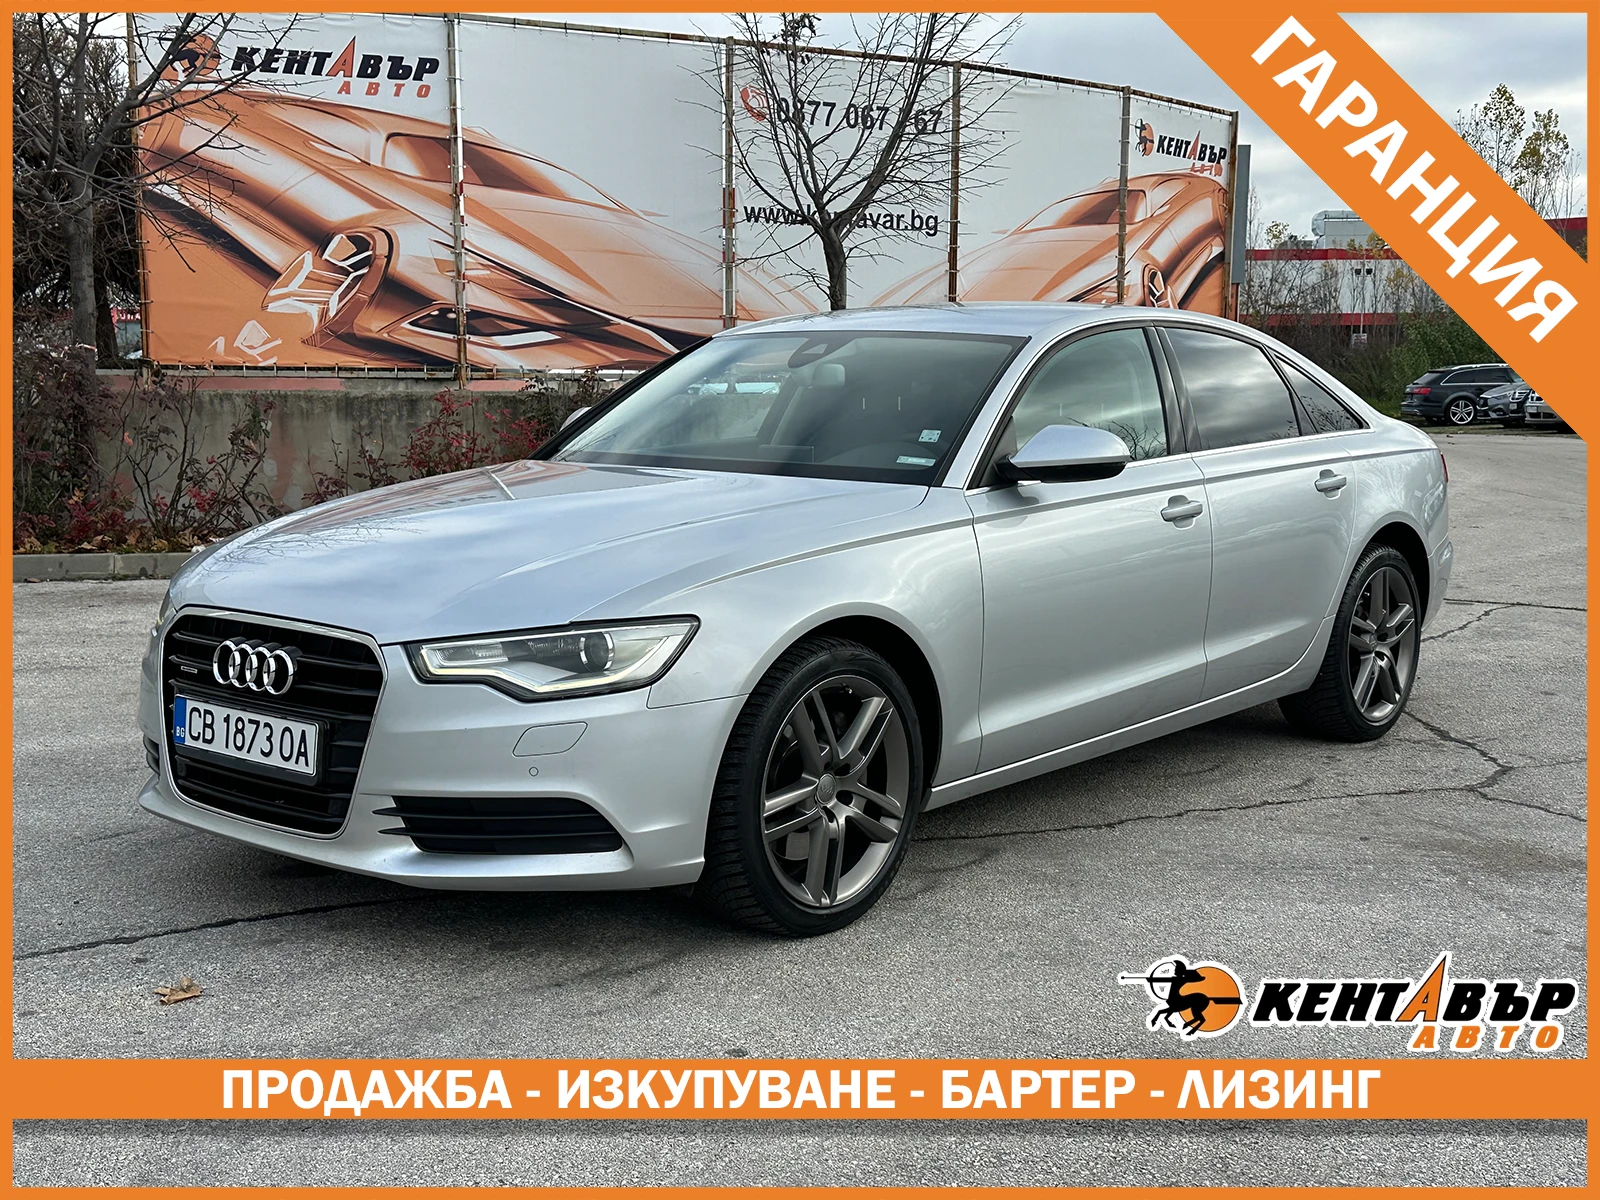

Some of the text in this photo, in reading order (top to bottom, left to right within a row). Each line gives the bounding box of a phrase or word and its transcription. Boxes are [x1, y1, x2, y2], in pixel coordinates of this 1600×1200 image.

[231, 35, 440, 81] КЕНТАВЪР
[337, 80, 431, 98] АВТО
[776, 97, 943, 133] 0877 067 67
[1156, 130, 1227, 164] КЕНТАВЪР
[175, 725, 185, 738] BG
[188, 706, 215, 745] CB
[223, 713, 274, 758] 1873
